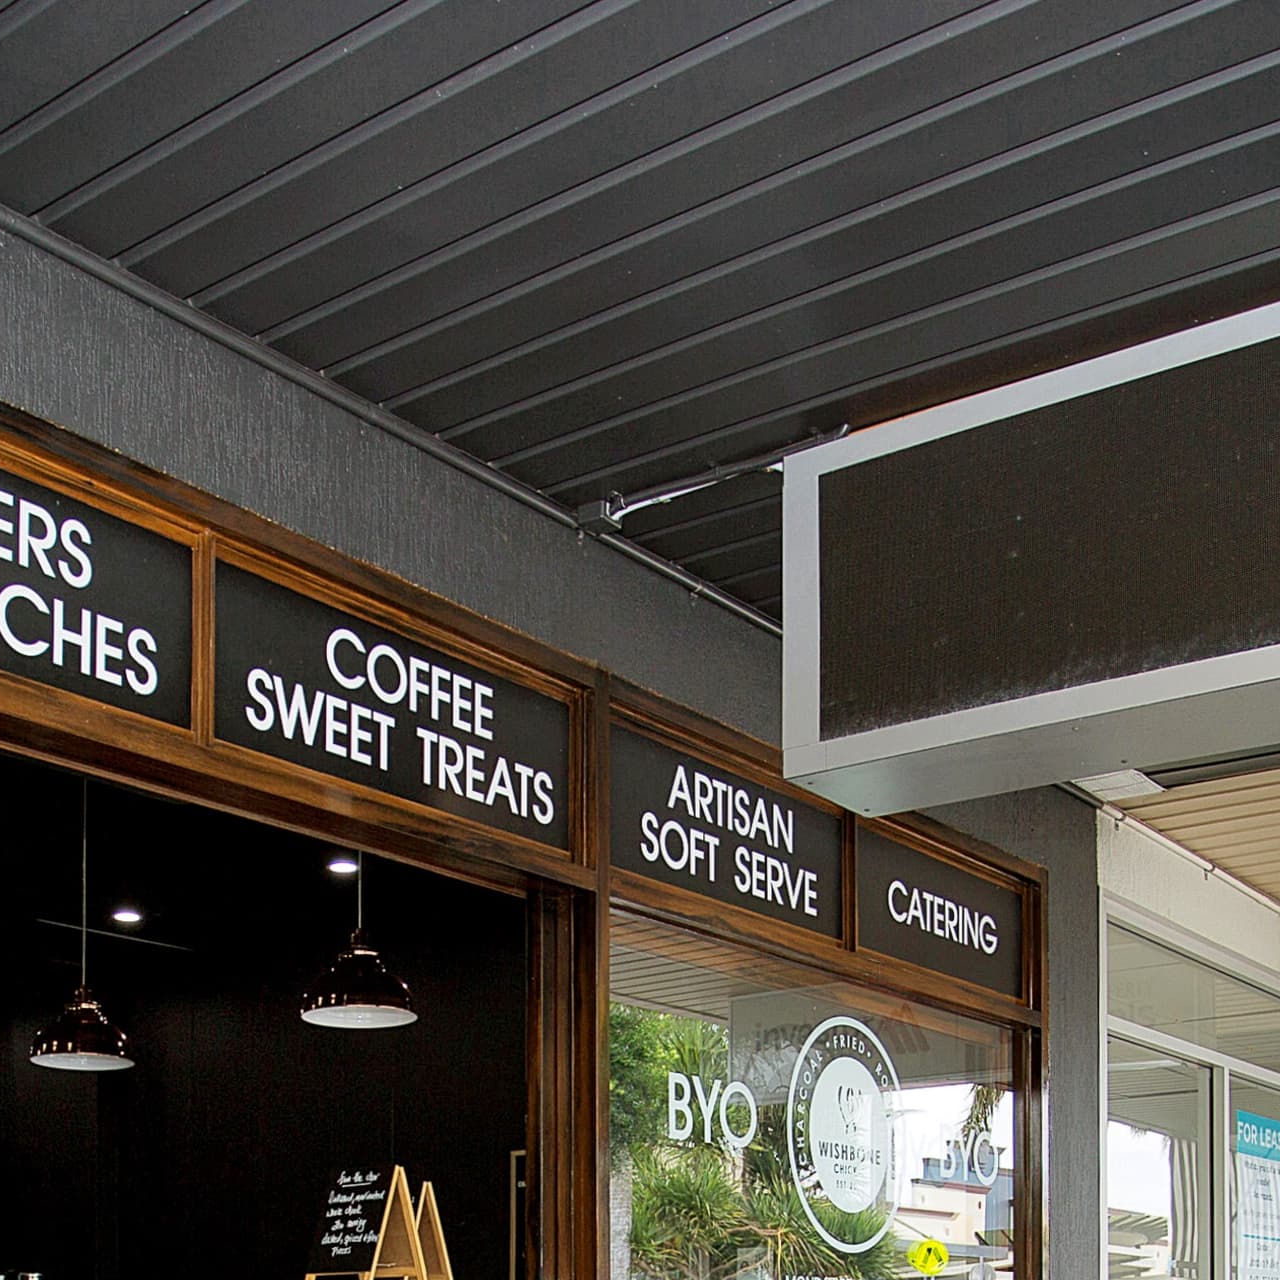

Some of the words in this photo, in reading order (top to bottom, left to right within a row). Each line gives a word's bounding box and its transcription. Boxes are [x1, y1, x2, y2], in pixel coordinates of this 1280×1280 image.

[325, 627, 494, 742] COFFEE
[245, 667, 395, 772] SWEET
[416, 726, 554, 825] TREATS
[668, 765, 794, 854] ARTISAN
[640, 812, 719, 883] SOFT
[734, 855, 819, 918] SERVE
[887, 880, 998, 955] CATERING
[833, 1035, 865, 1054] FRIED
[667, 1071, 758, 1149] BYO
[797, 1050, 823, 1164] CHARCOAL
[1237, 1121, 1258, 1145] FOR
[818, 1140, 881, 1165] WISHBONE
